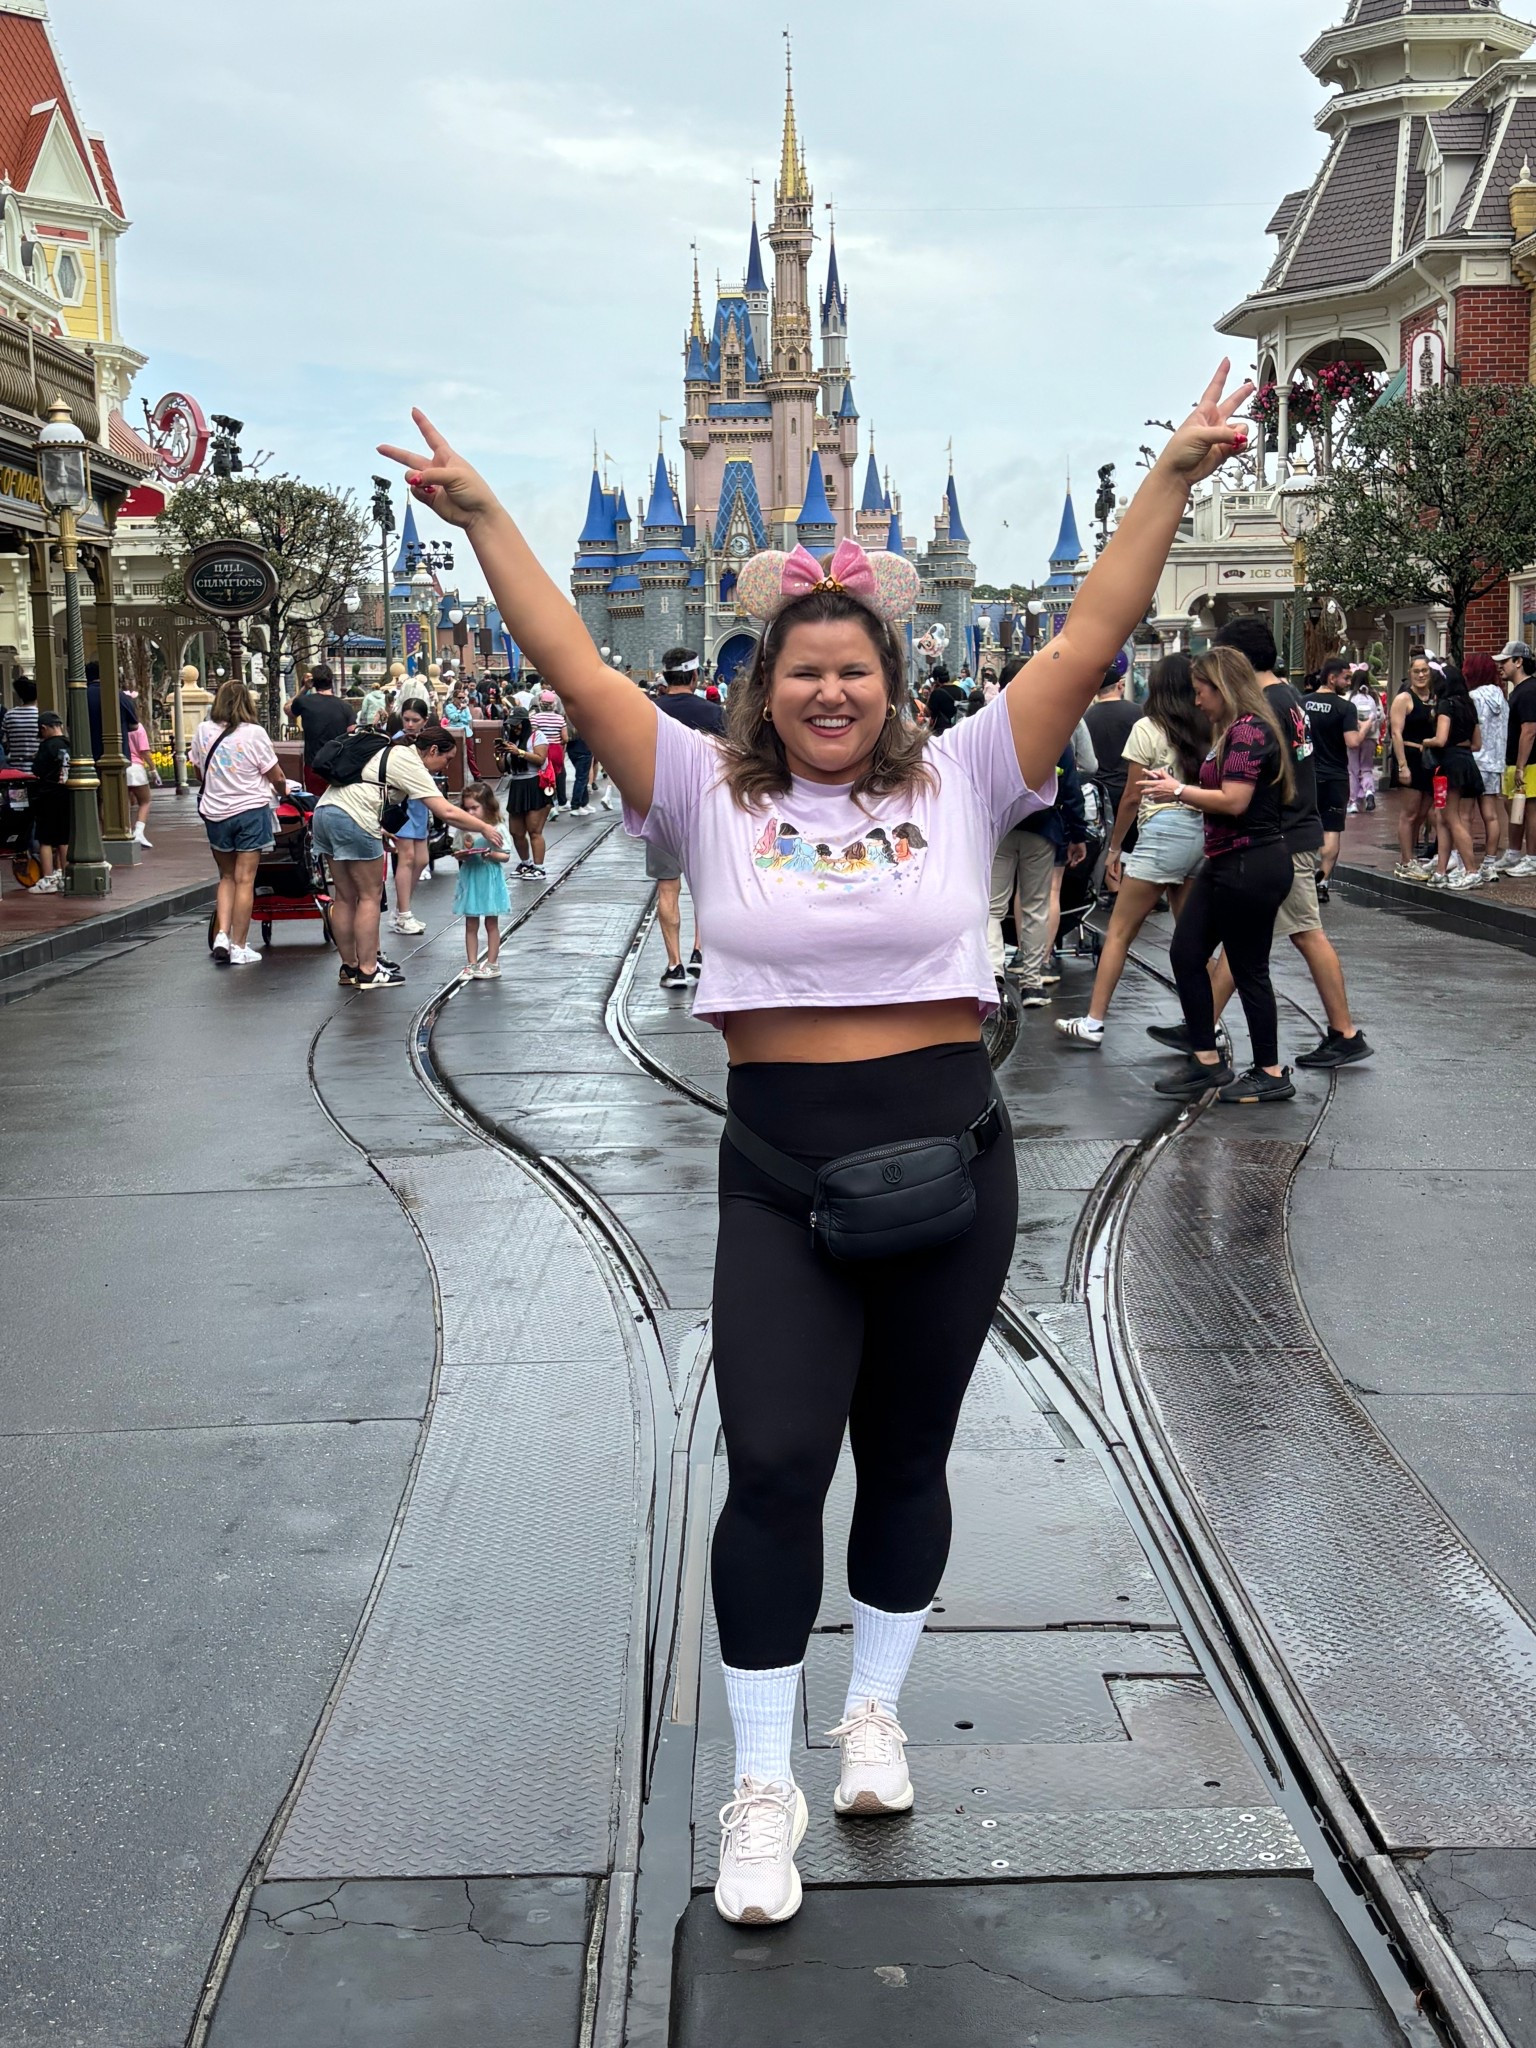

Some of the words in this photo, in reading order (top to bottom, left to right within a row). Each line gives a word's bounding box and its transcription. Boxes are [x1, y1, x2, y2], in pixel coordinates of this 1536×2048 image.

[3, 466, 18, 494] OF
[213, 564, 244, 573] HALL
[1250, 569, 1271, 579] ICE
[1275, 568, 1293, 578] CR
[196, 578, 263, 588] CHAMPIONS
